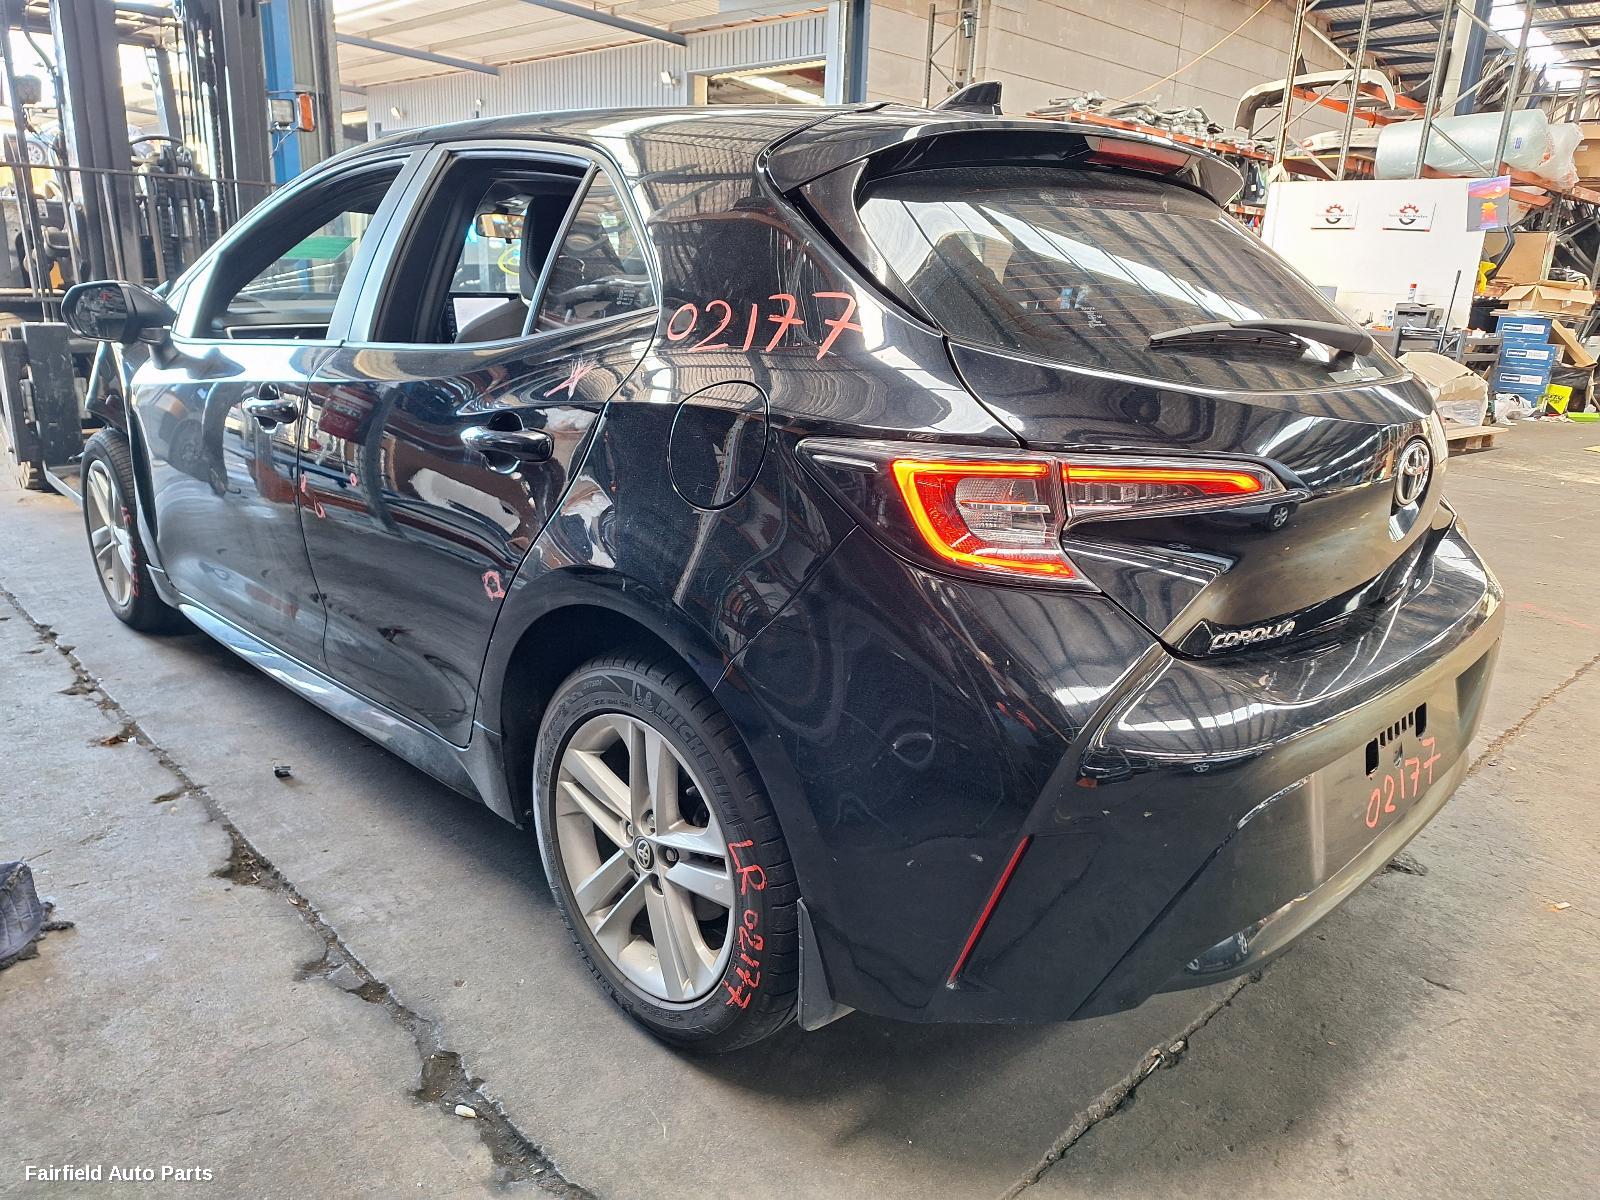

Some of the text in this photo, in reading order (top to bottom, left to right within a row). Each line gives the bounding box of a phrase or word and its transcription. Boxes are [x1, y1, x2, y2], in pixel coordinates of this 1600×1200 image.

[667, 291, 864, 361] 02177
[1209, 620, 1296, 651] COROLLA
[1365, 736, 1441, 829] 02177
[722, 839, 768, 1009] LR 02177
